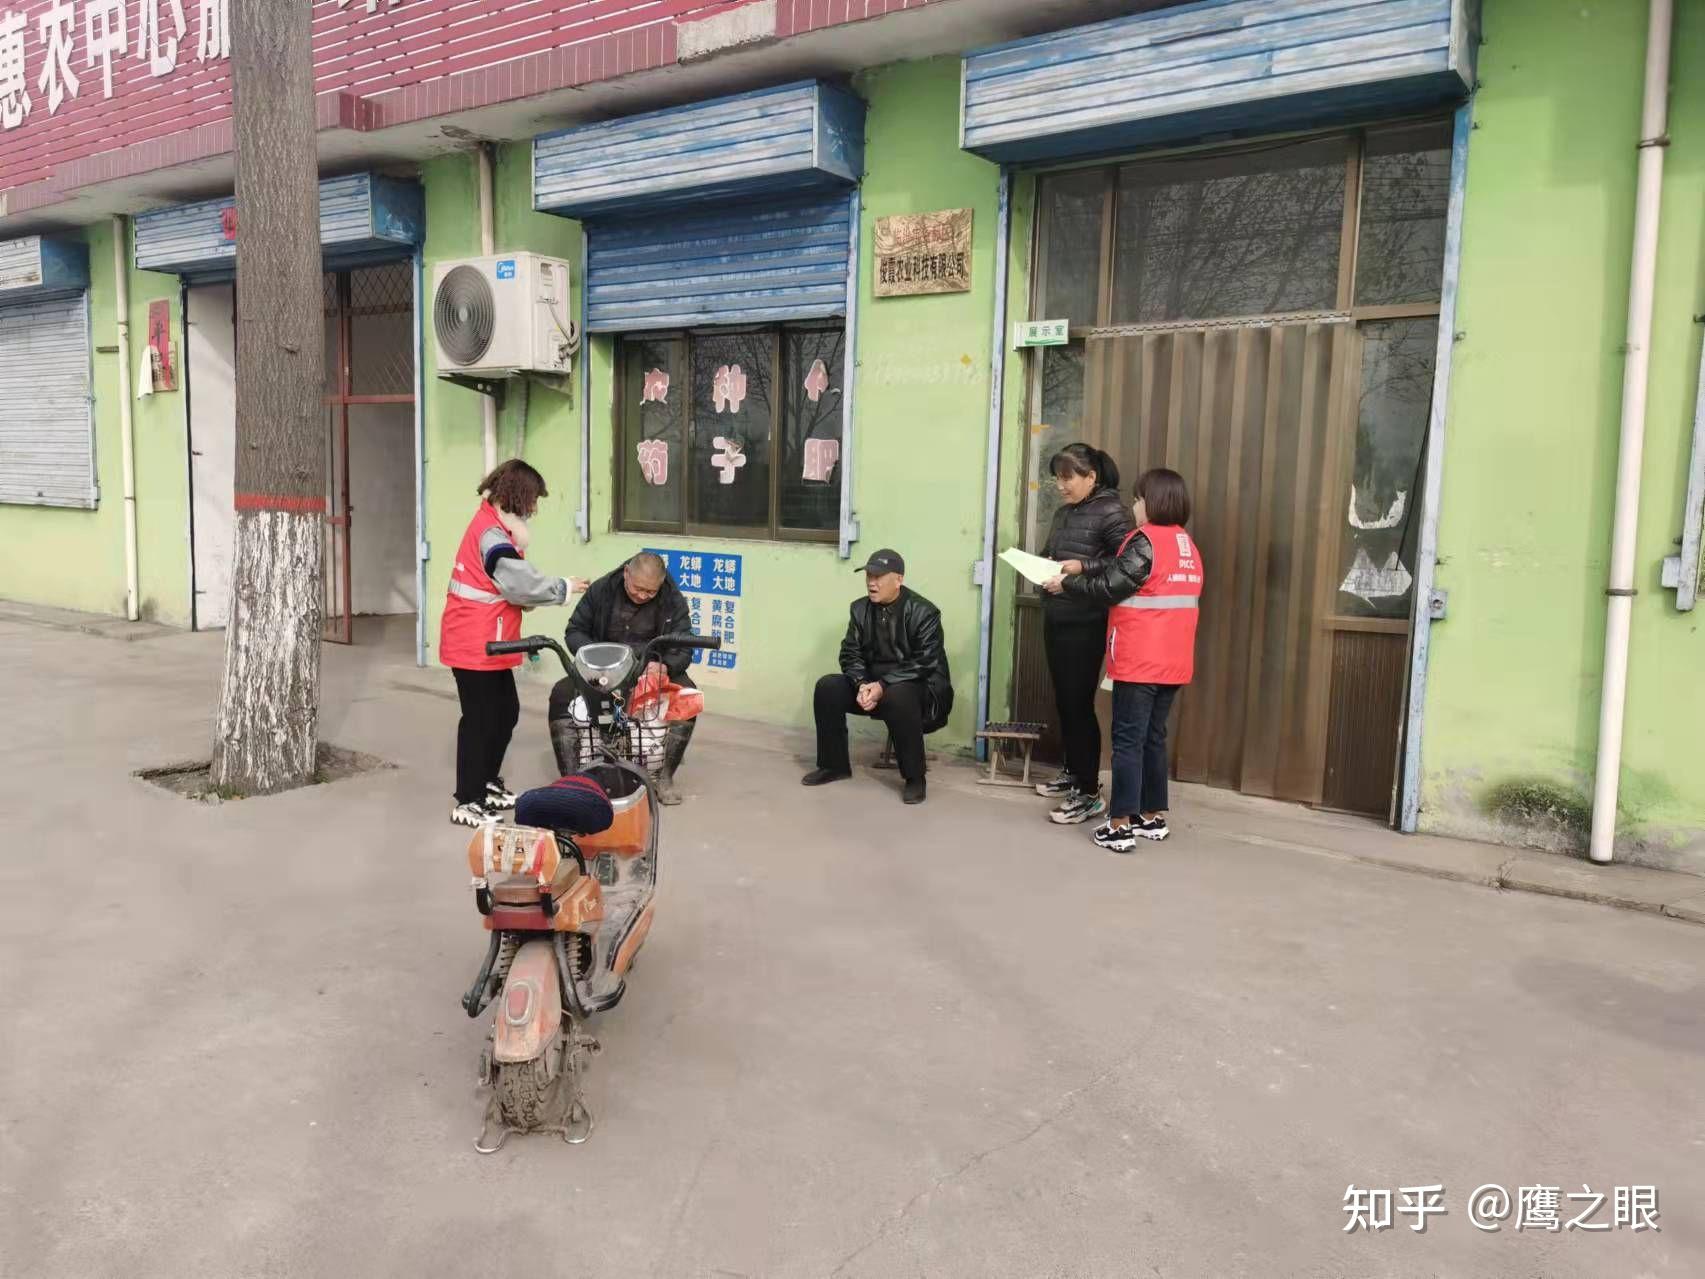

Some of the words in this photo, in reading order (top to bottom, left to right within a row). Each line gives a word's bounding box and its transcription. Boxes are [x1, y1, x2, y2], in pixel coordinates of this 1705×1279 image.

[1029, 325, 1065, 337] 展示室
[1178, 559, 1195, 569] PICC
[679, 573, 702, 588] 大地
[713, 576, 736, 592] 大地
